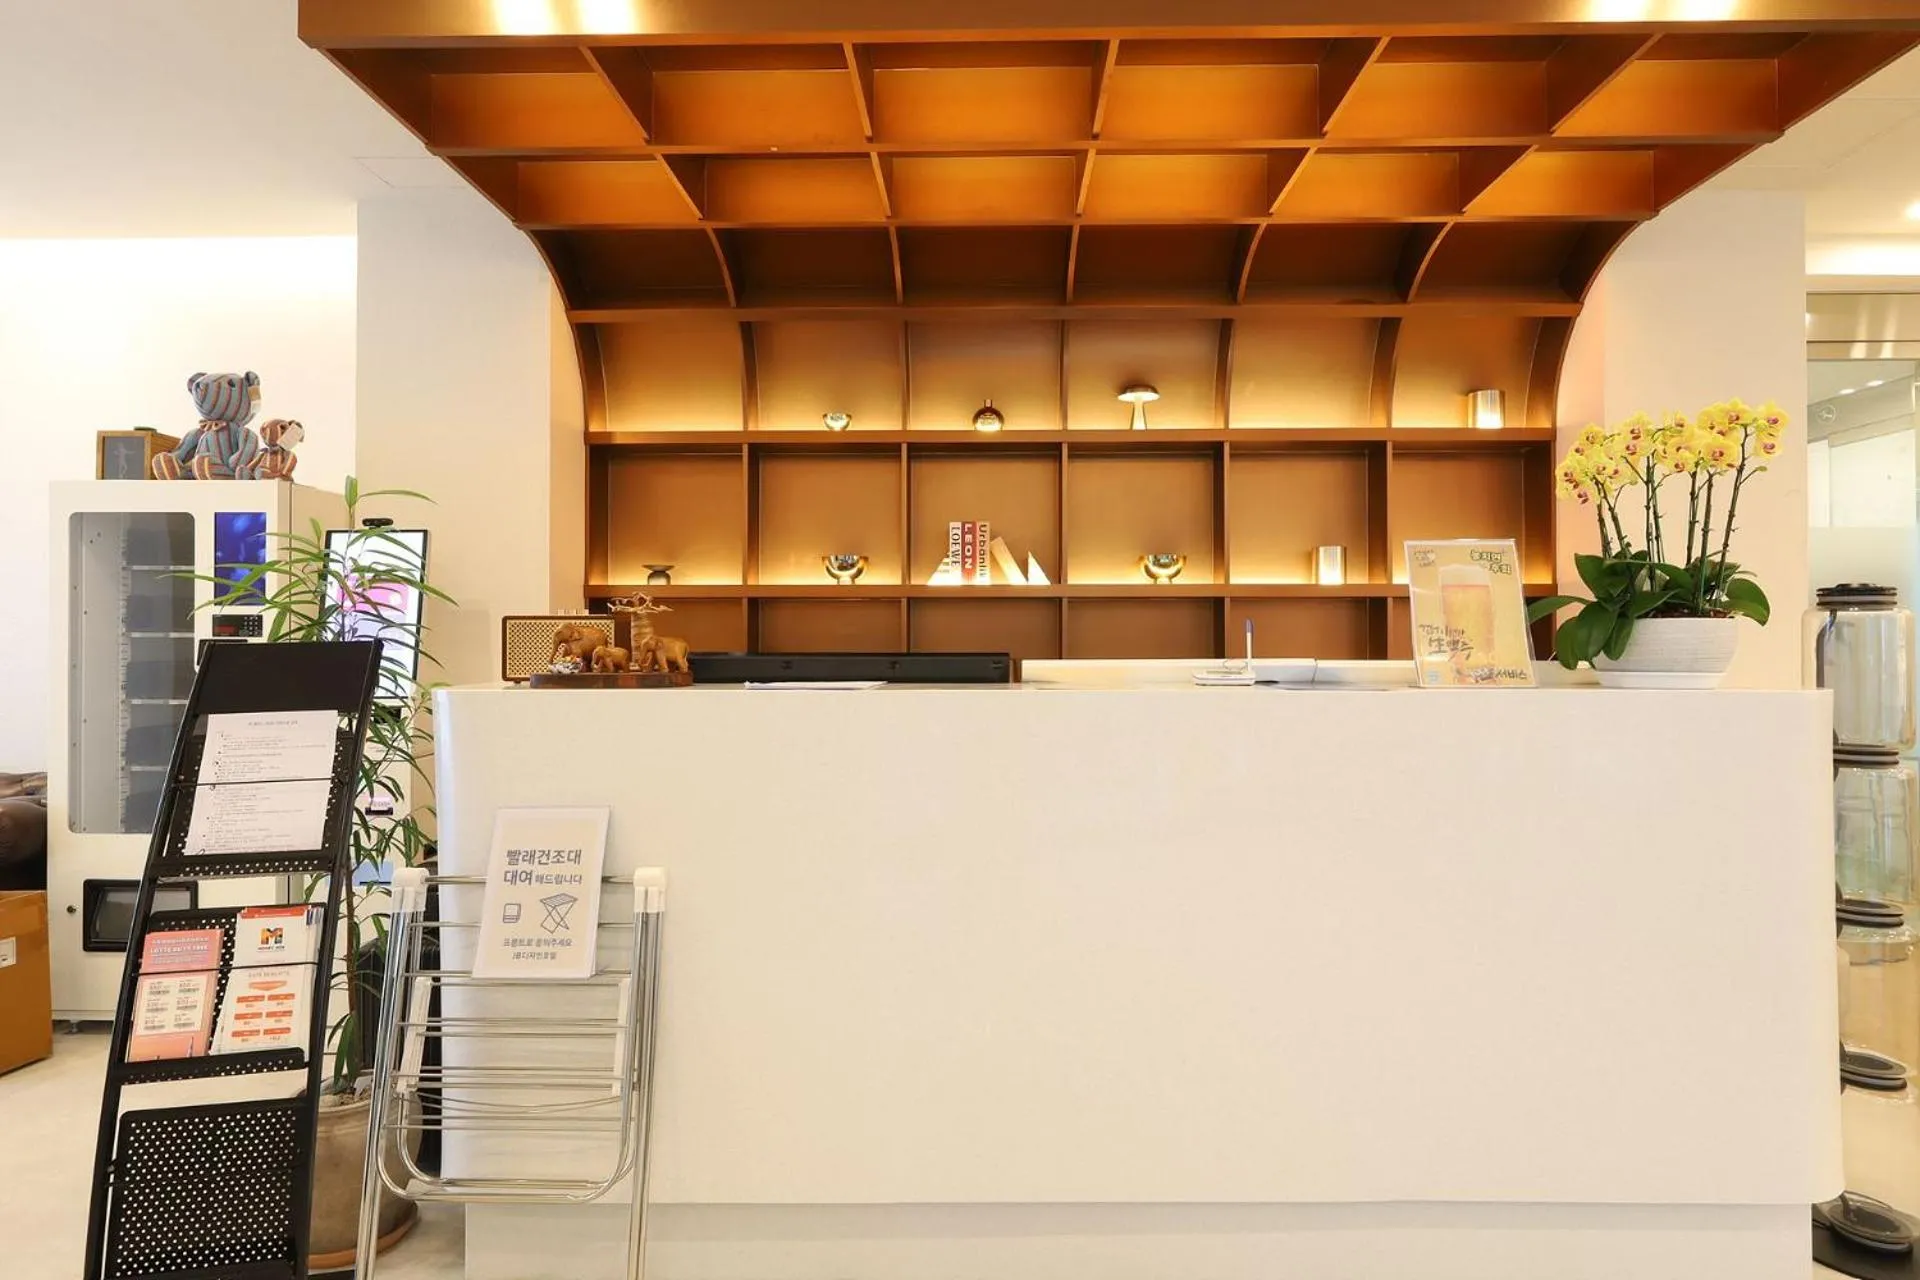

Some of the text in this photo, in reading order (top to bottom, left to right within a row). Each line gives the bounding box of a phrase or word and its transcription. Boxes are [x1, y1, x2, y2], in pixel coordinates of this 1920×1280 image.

[952, 526, 960, 567] LOEWE
[964, 523, 973, 569] LEON
[1494, 668, 1527, 680] 서비스
[507, 849, 582, 866] 빨래건조대
[504, 869, 582, 886] 대여 해드립니다
